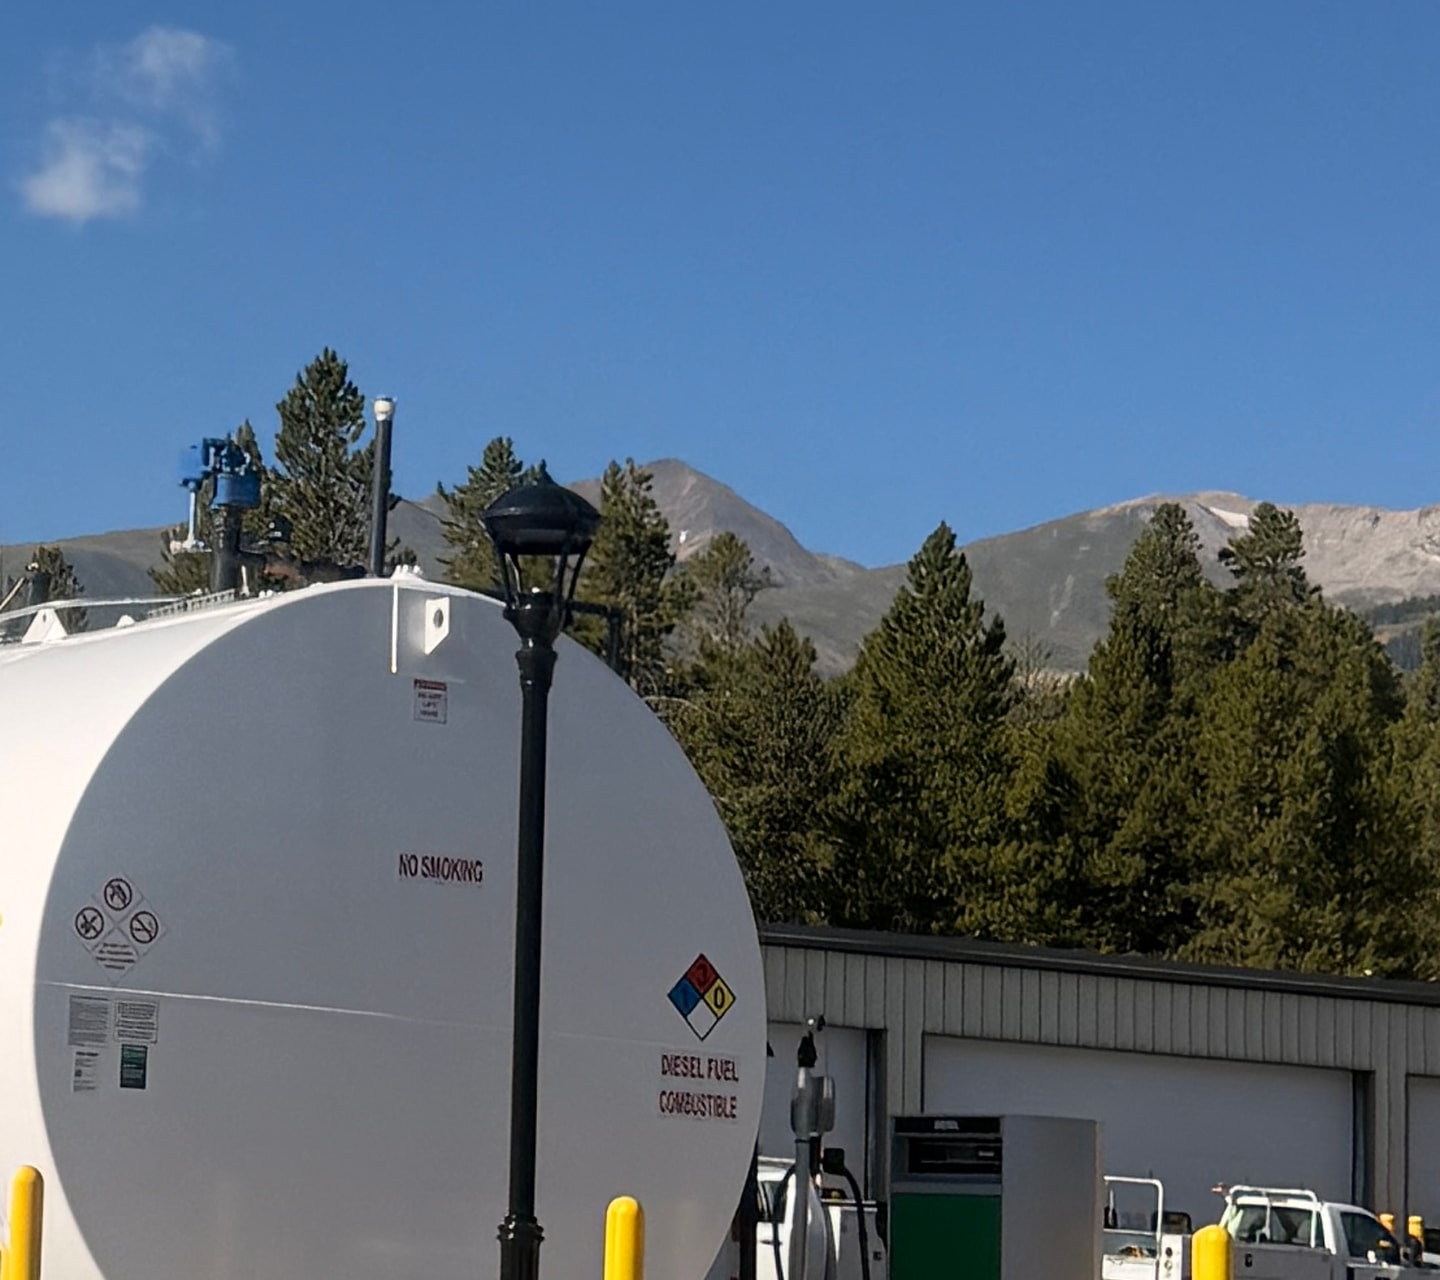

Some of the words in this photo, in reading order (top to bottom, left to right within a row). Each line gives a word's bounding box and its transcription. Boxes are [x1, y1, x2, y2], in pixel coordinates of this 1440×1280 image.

[399, 854, 418, 877] NO
[421, 855, 483, 883] SMOKING
[714, 986, 725, 1009] 0
[661, 1054, 704, 1078] DIESEL
[707, 1057, 739, 1082] FUEL
[659, 1090, 737, 1118] COMBUSTIBLE
